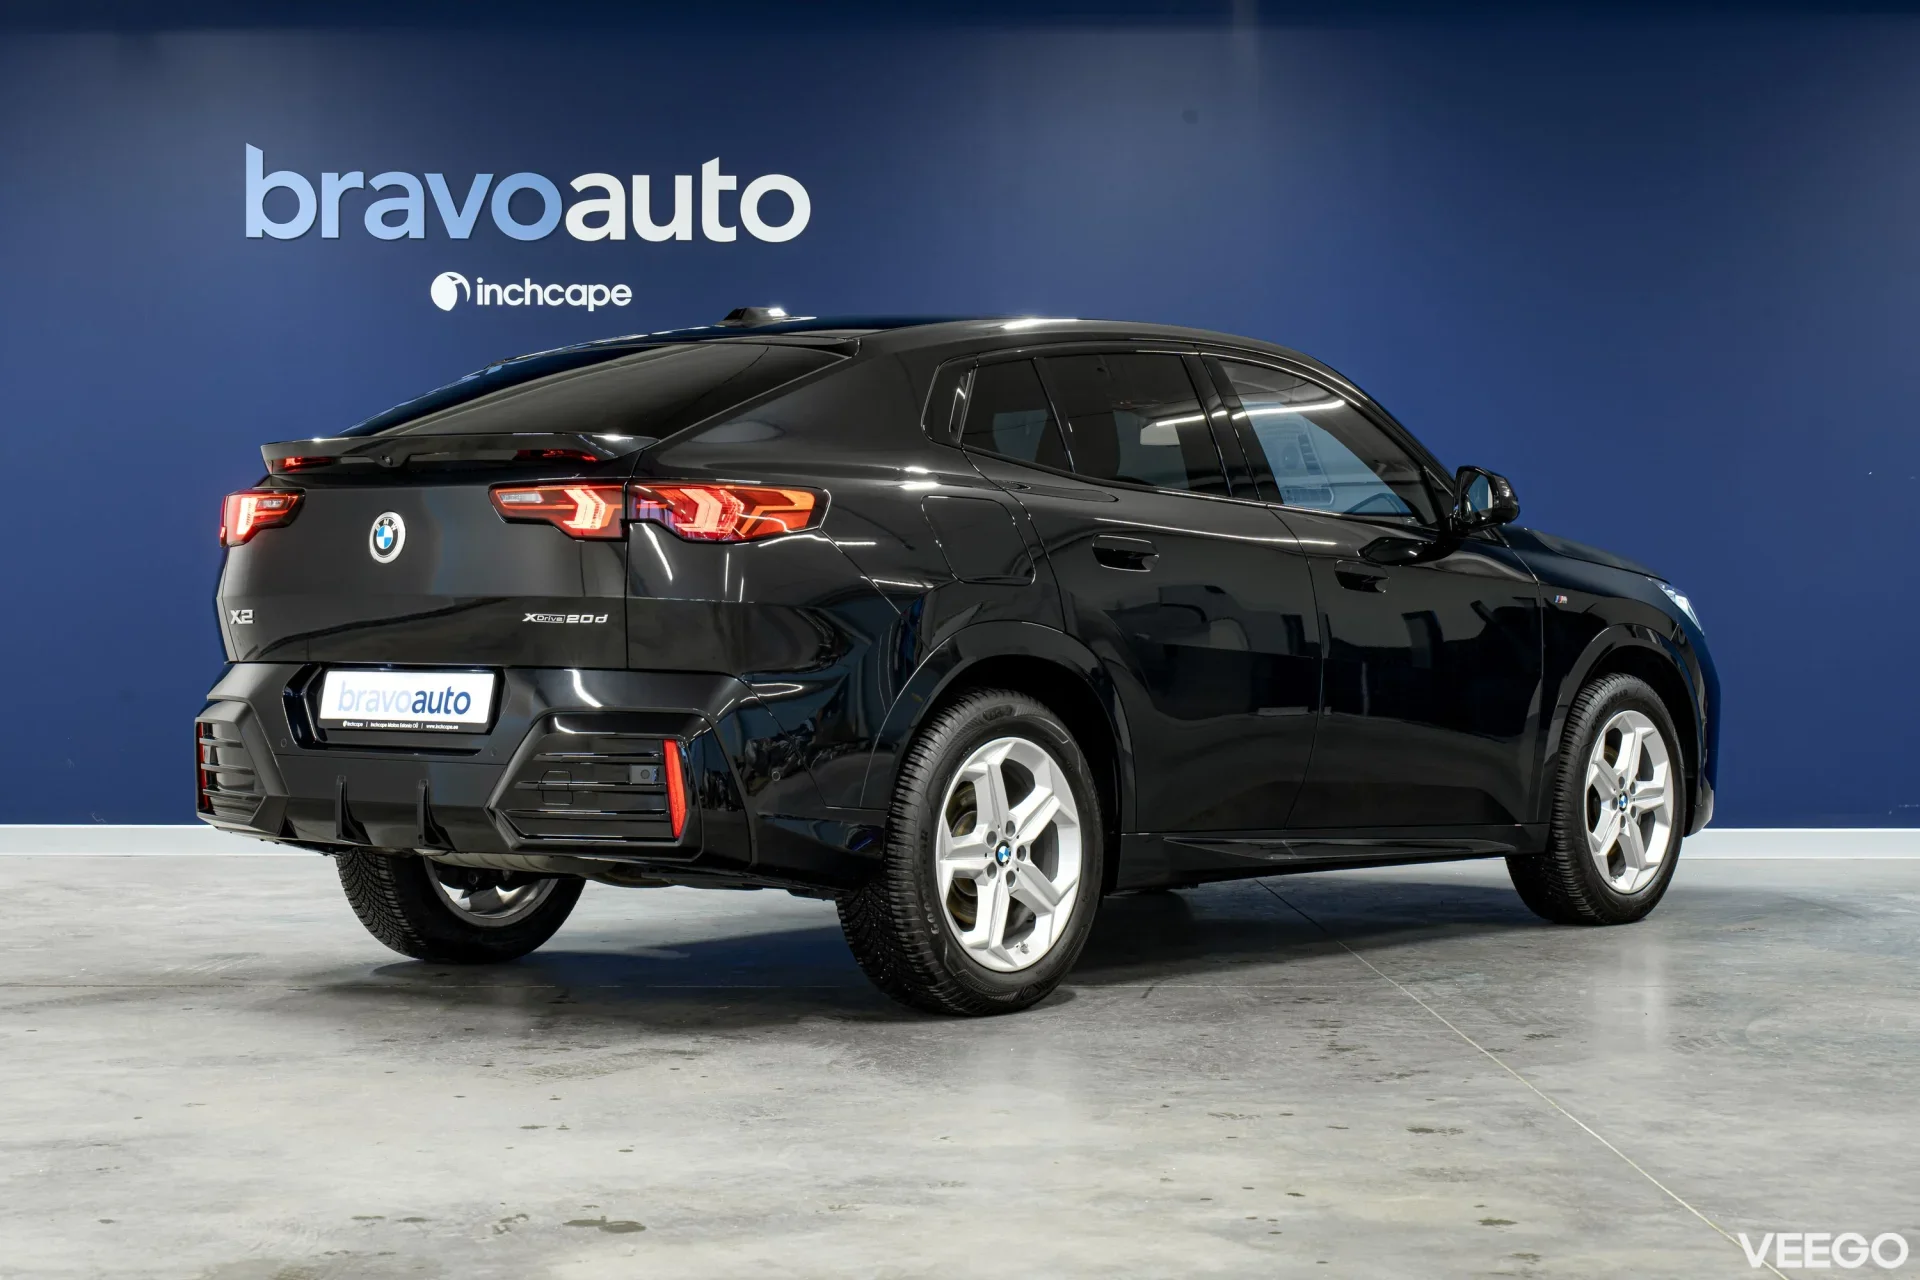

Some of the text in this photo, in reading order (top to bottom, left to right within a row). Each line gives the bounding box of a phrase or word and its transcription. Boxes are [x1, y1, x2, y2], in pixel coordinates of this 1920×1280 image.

[246, 142, 812, 242] bravoauto
[476, 277, 633, 312] inchcape
[375, 518, 398, 531] BMW
[230, 609, 254, 625] X2
[337, 680, 472, 715] bravoauto
